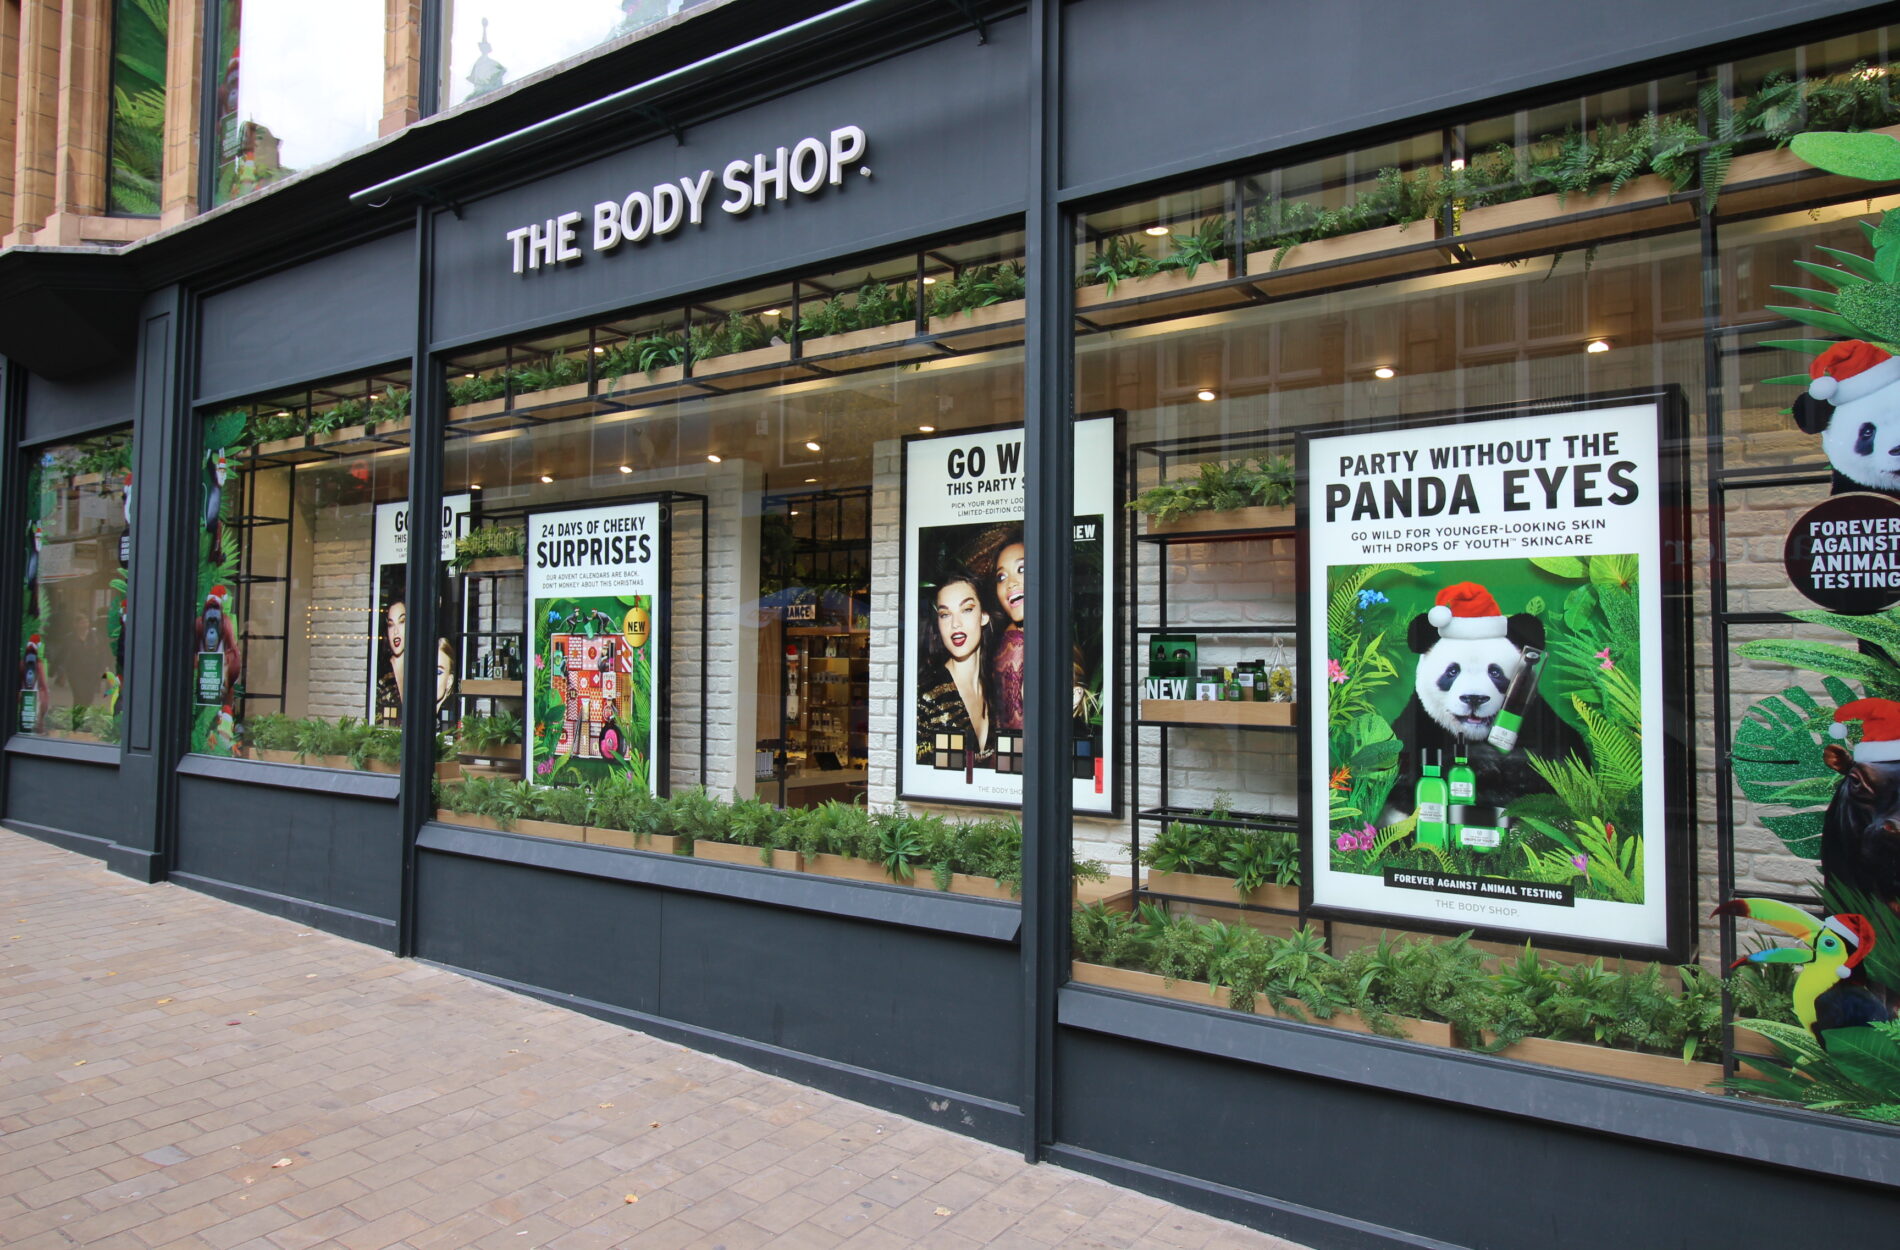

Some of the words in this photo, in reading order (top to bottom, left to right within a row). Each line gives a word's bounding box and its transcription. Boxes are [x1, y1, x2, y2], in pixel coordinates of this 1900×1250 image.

[507, 211, 582, 274] THE
[594, 170, 714, 251] BODY
[947, 446, 986, 479] GO
[1340, 450, 1419, 477] PARTY
[1429, 437, 1551, 470] WITHOUT
[1563, 431, 1619, 459] THE
[947, 481, 973, 496] THIS
[977, 477, 1016, 493] PARTY
[1326, 473, 1480, 523] PANDA
[1503, 460, 1640, 513] EYES
[958, 507, 1011, 516] LIMITED-EDITION
[542, 524, 554, 538] 24
[558, 521, 583, 537] DAYS
[587, 520, 600, 534] OF
[603, 516, 645, 533] CHEEKY
[1073, 524, 1096, 539] EW
[1351, 532, 1367, 541] GO
[1372, 530, 1401, 540] WILD
[1406, 528, 1430, 538] FOR
[1436, 521, 1566, 537] YOUNGER-LOOKING
[1572, 519, 1606, 530] SKIN
[1810, 518, 1900, 537] FOREVER
[537, 534, 651, 569] SURPRISES
[1362, 544, 1392, 554] WITH
[1396, 542, 1438, 553] DROPS
[1443, 541, 1459, 550] OF
[1521, 534, 1593, 547] SKINCARE
[1811, 534, 1900, 554] AGAINST
[1811, 552, 1900, 572] ANIMAL
[1811, 571, 1900, 589] TESTING
[788, 606, 810, 618] ANCE
[628, 621, 646, 633] NEW
[1147, 679, 1188, 700] NEW
[1394, 874, 1435, 887] FOREVER
[1437, 878, 1477, 892] AGAINST
[1480, 882, 1517, 896] ANIMAL
[1520, 887, 1563, 900] TESTING
[1435, 899, 1455, 910] THE
[1458, 901, 1486, 913] BODY
